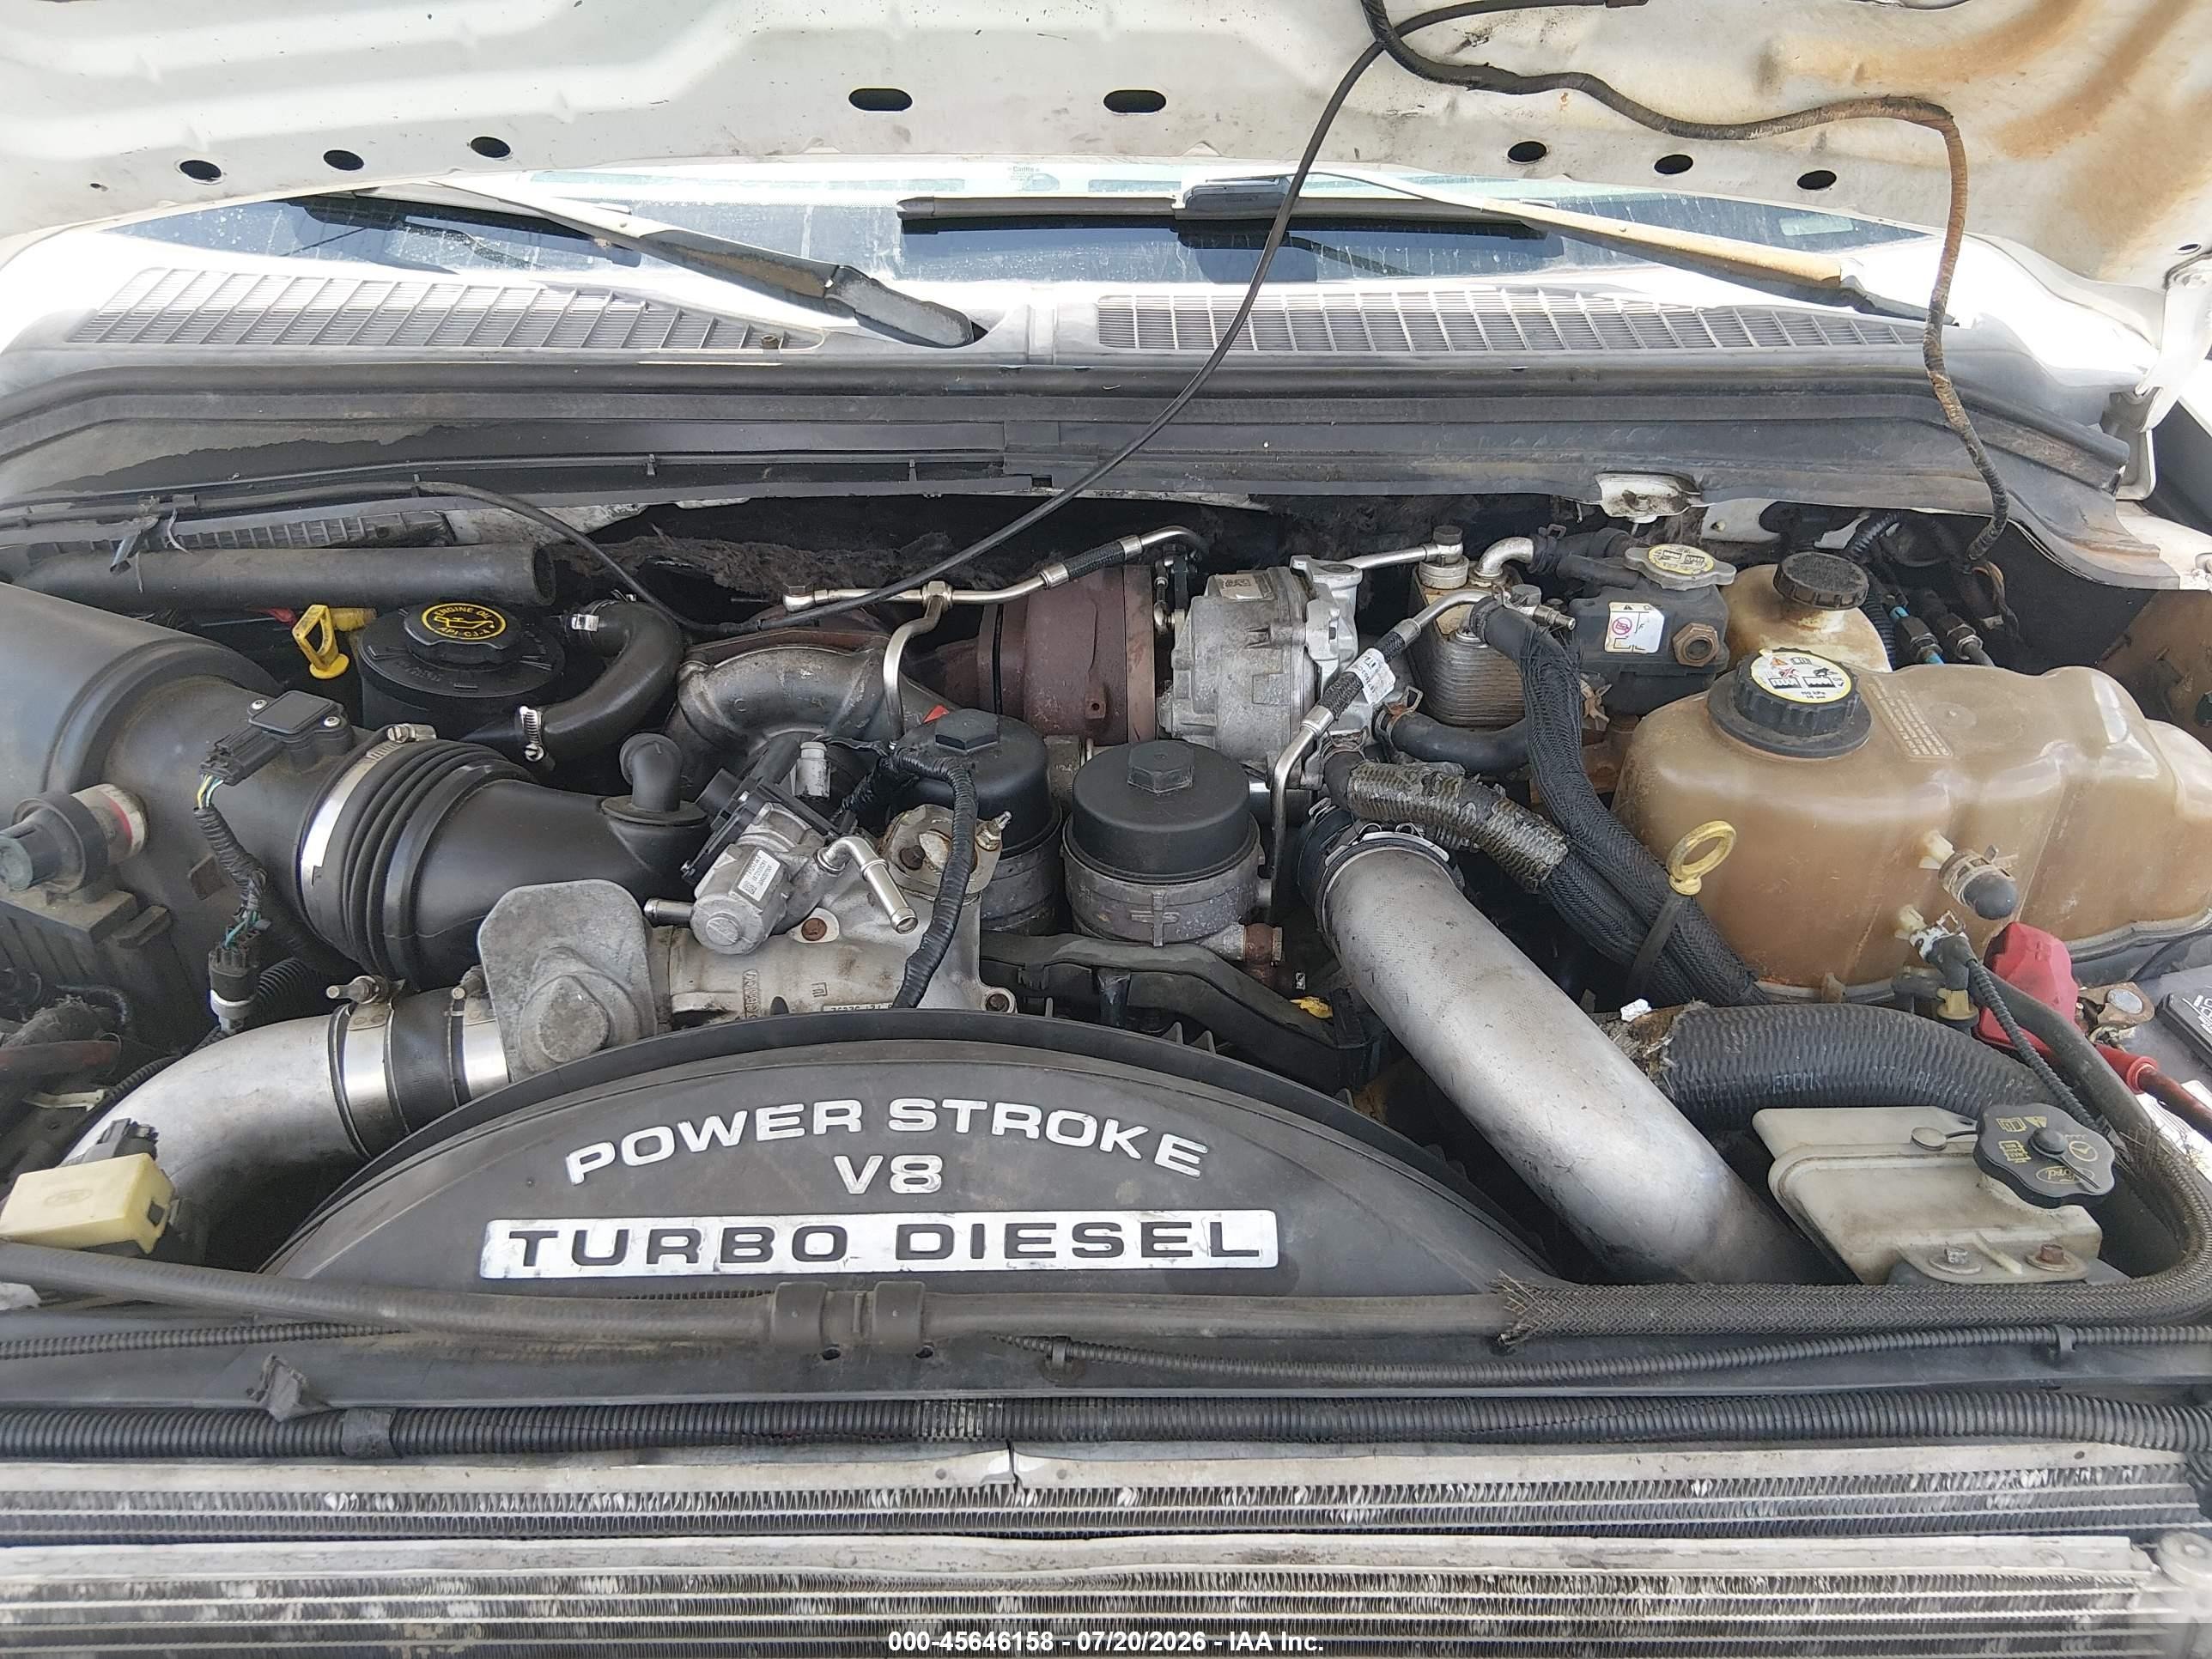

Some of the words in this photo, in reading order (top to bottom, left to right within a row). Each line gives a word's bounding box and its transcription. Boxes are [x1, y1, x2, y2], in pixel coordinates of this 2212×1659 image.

[432, 606, 475, 617] ENGINE
[476, 611, 493, 620] OIL
[436, 627, 459, 635] API
[464, 629, 491, 637] CJ-4
[565, 1098, 863, 1186] POWER
[888, 1097, 1208, 1179] STROKE
[832, 1154, 944, 1195] V8
[508, 1224, 848, 1268] TURBO
[895, 1221, 1260, 1261] DIESEL
